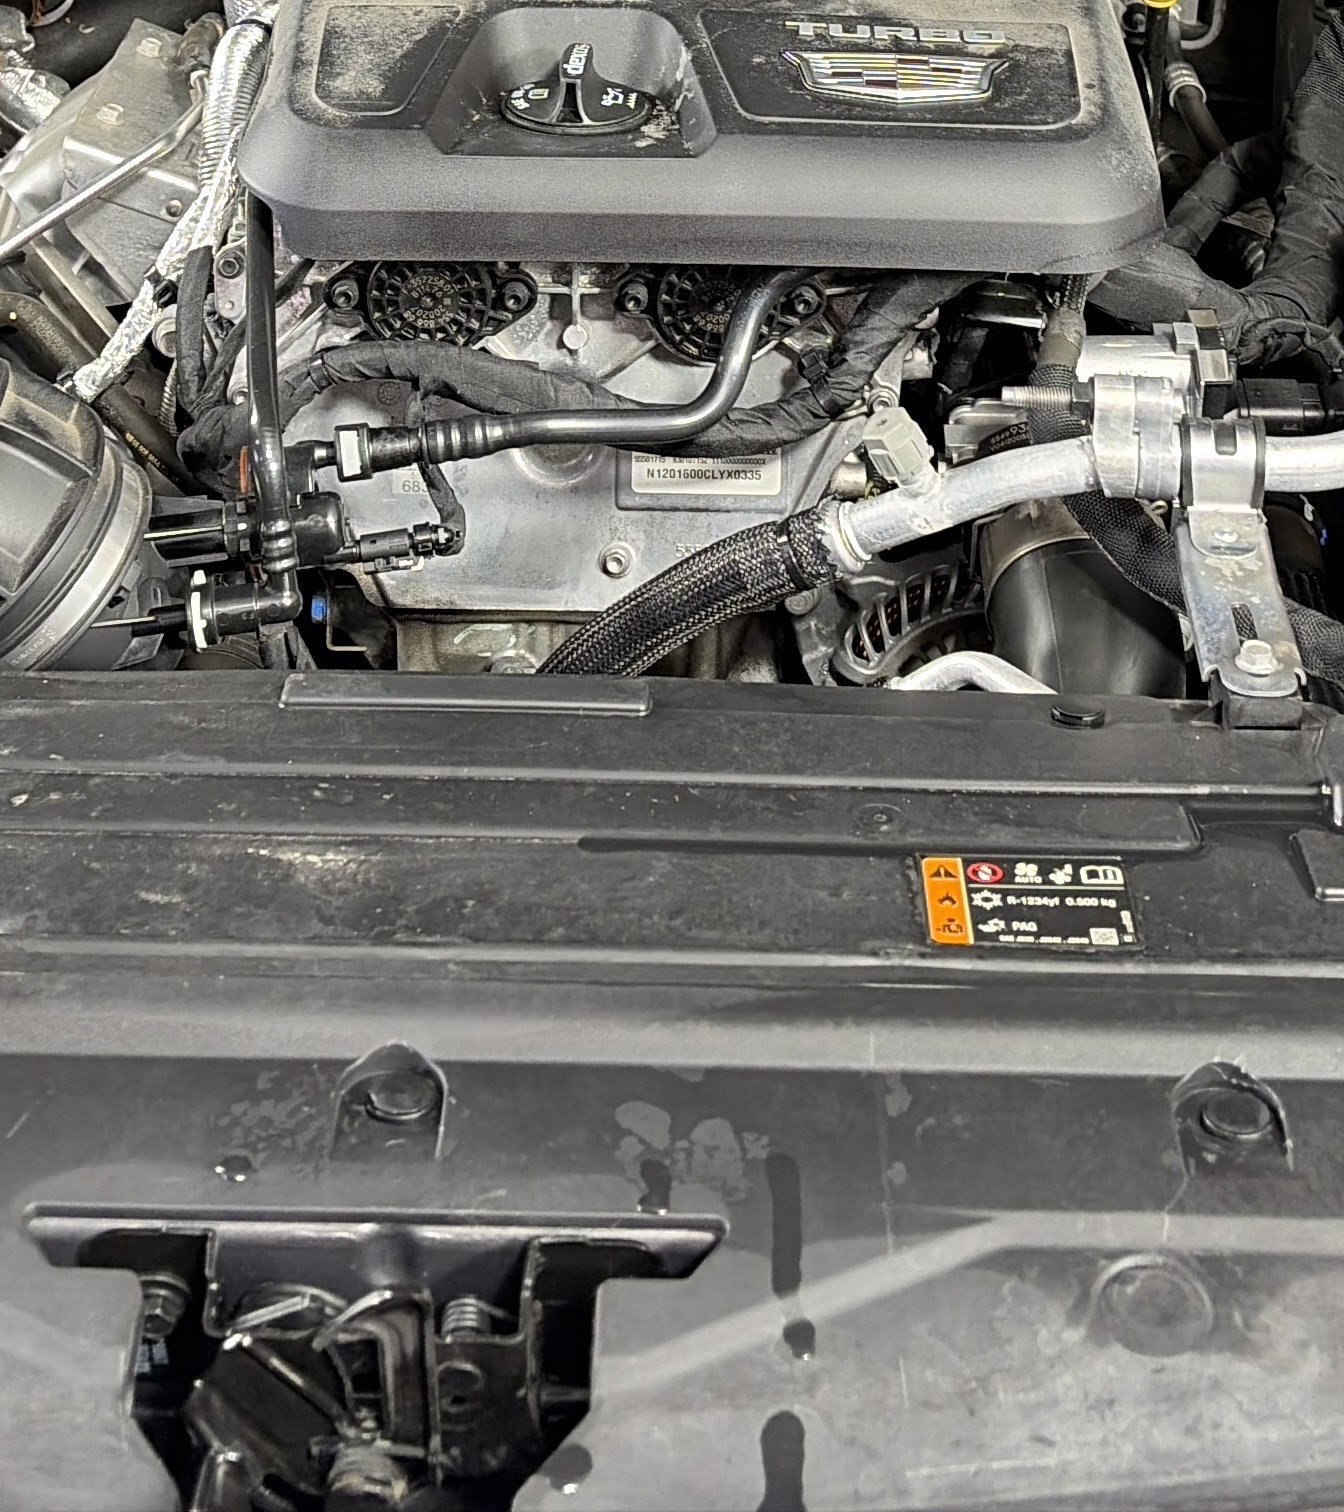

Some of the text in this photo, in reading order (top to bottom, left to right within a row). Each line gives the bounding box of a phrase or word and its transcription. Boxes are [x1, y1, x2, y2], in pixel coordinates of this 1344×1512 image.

[785, 21, 1005, 44] TURBO
[1014, 875, 1043, 884] AUTO
[1006, 895, 1060, 908] R-1234yf
